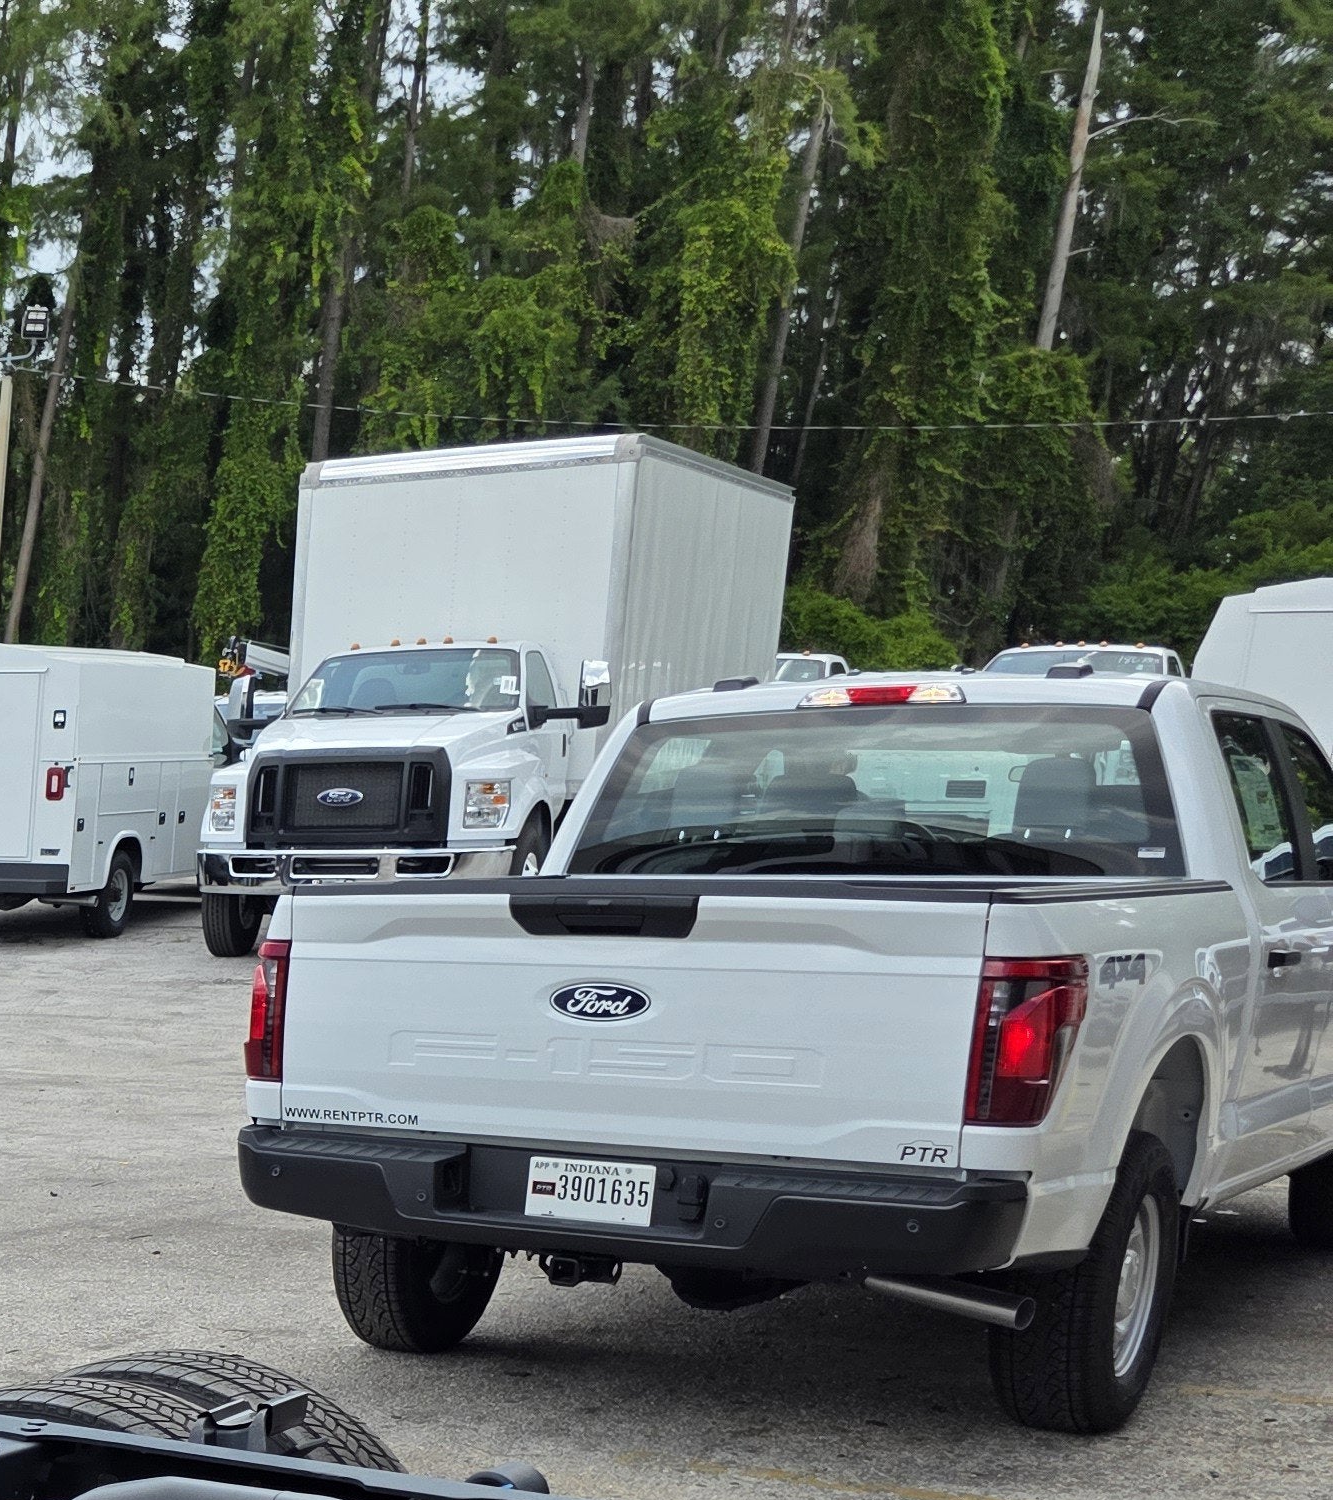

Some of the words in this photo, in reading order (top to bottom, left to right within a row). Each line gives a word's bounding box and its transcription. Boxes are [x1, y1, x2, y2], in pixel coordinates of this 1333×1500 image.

[566, 987, 632, 1015] Ford
[388, 1029, 823, 1088] F-150
[285, 1107, 419, 1126] WWW.RENTPTR.COM
[900, 1146, 948, 1163] PTR
[534, 1161, 550, 1169] APP
[564, 1163, 620, 1176] INDIANA
[557, 1174, 650, 1208] 3901635
